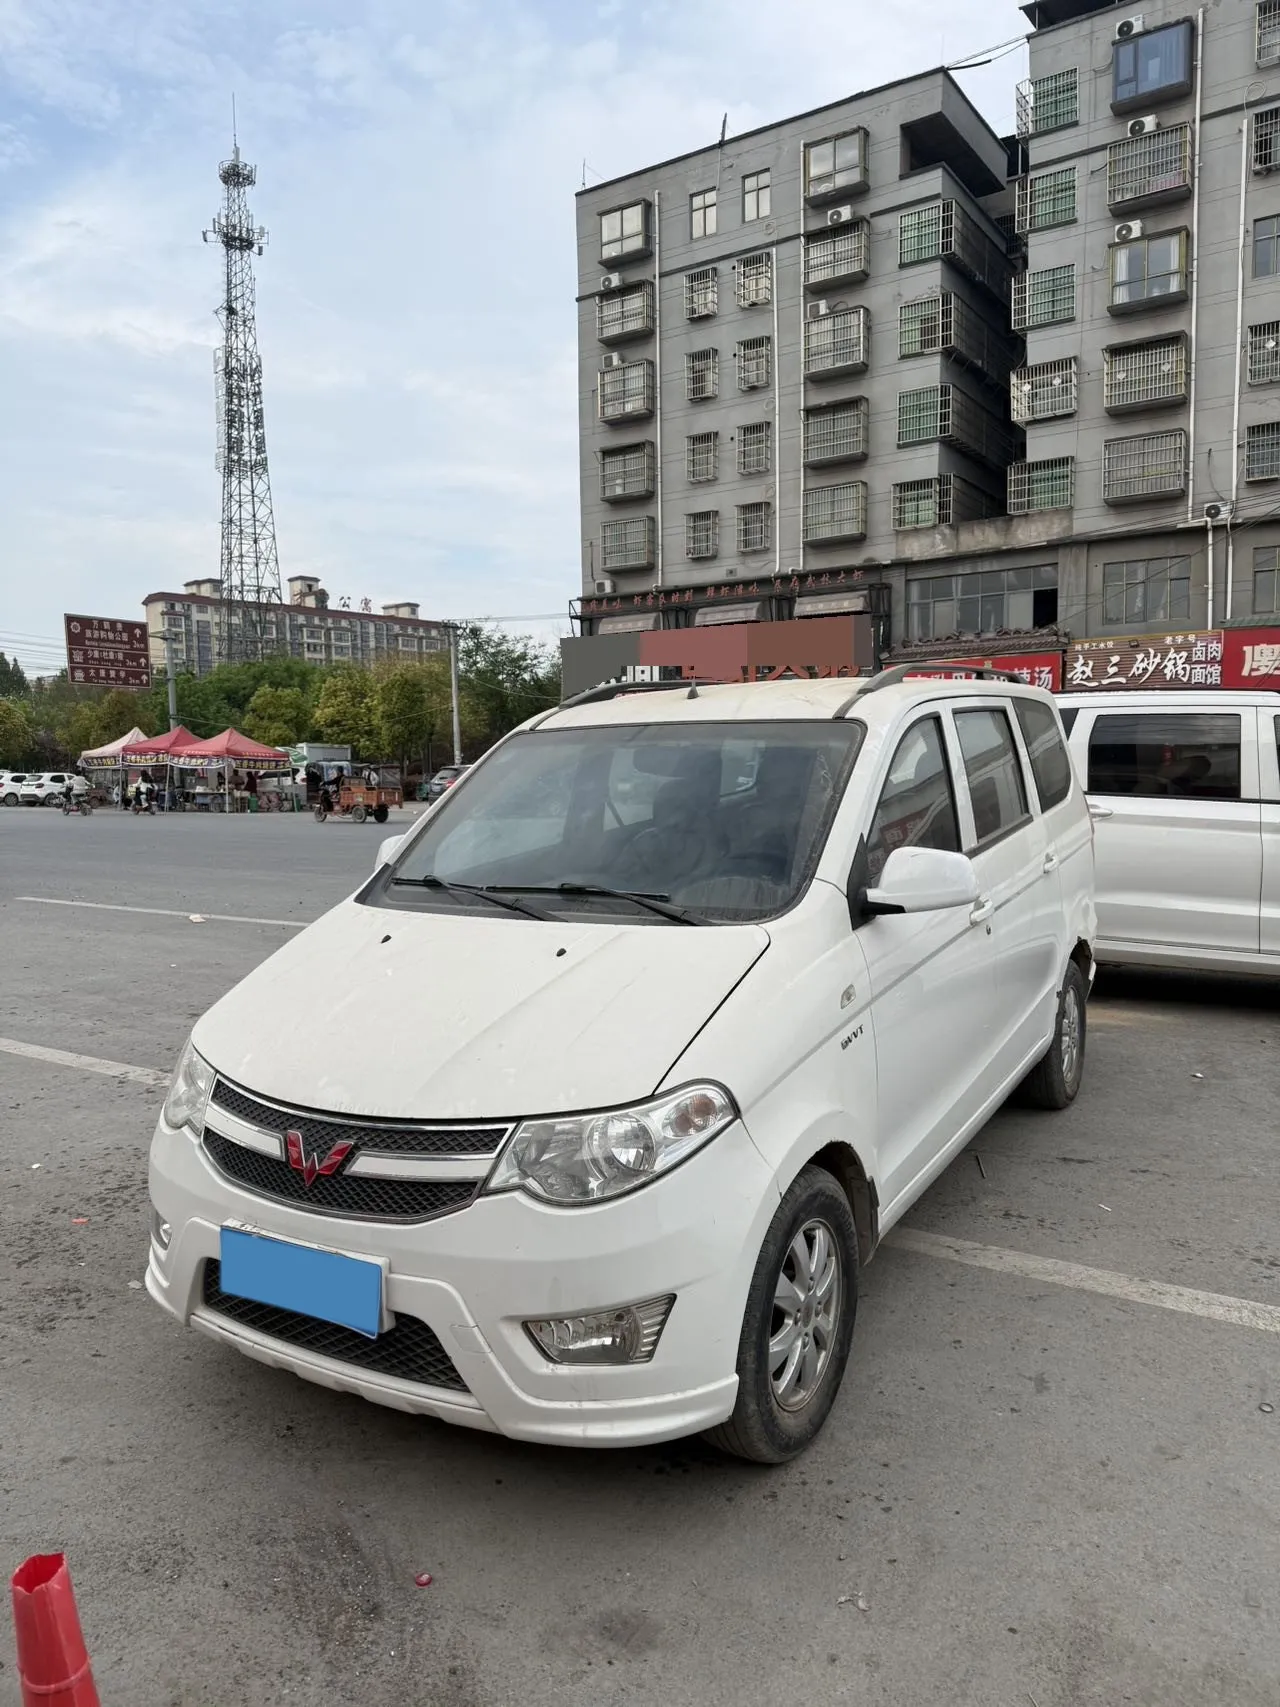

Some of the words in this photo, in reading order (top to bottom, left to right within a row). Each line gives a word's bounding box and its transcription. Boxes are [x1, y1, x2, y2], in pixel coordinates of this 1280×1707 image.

[1164, 633, 1196, 645] 老字号
[1192, 640, 1222, 662] 卤肉
[1066, 647, 1191, 687] 赵三砂锅
[1191, 663, 1222, 685] 面馆
